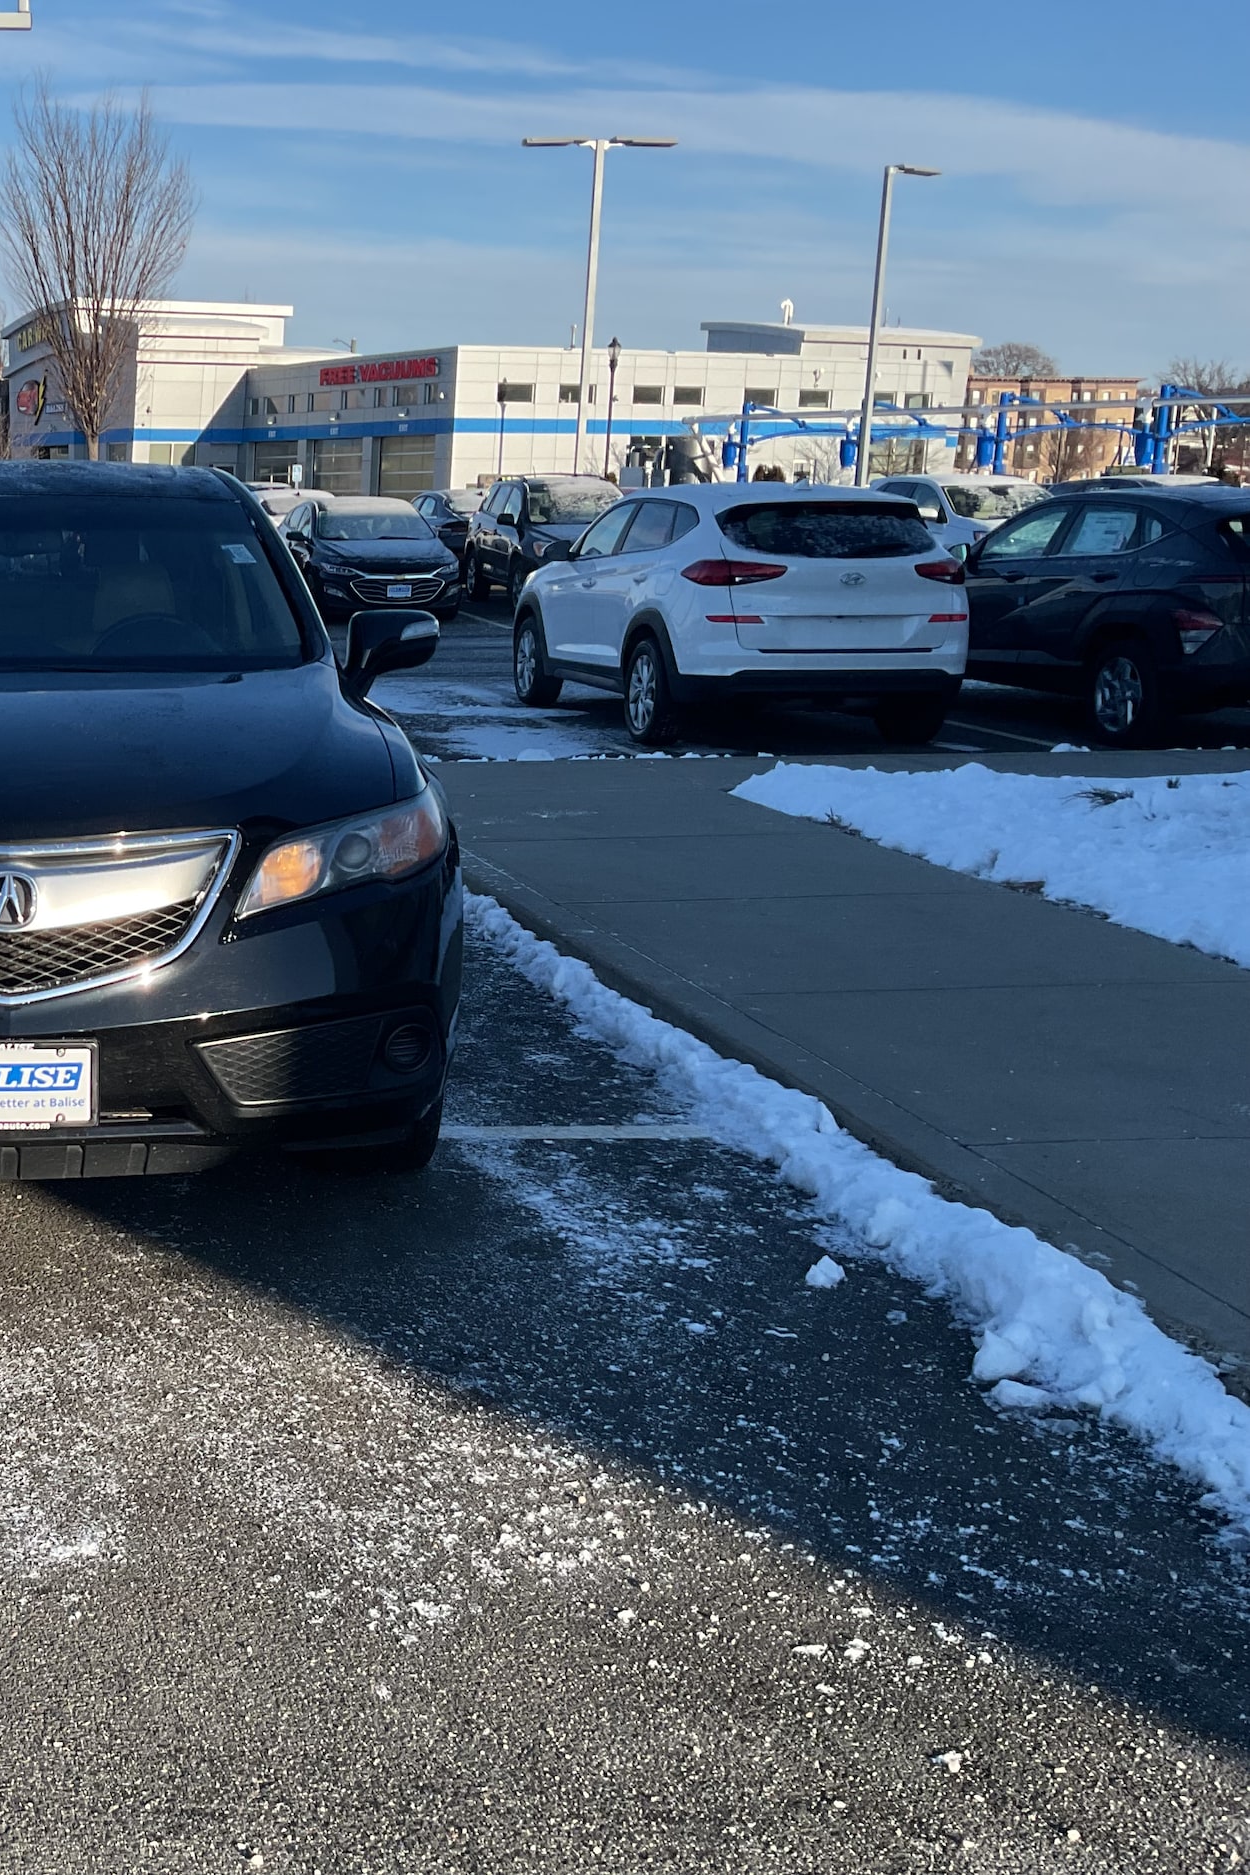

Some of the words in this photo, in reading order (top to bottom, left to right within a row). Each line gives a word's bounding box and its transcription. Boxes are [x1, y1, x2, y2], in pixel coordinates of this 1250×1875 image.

[17, 328, 33, 352] CAR
[320, 365, 356, 386] FREE
[359, 356, 438, 382] VACUUMS
[33, 1098, 46, 1107] at
[49, 1097, 85, 1107] Balise
